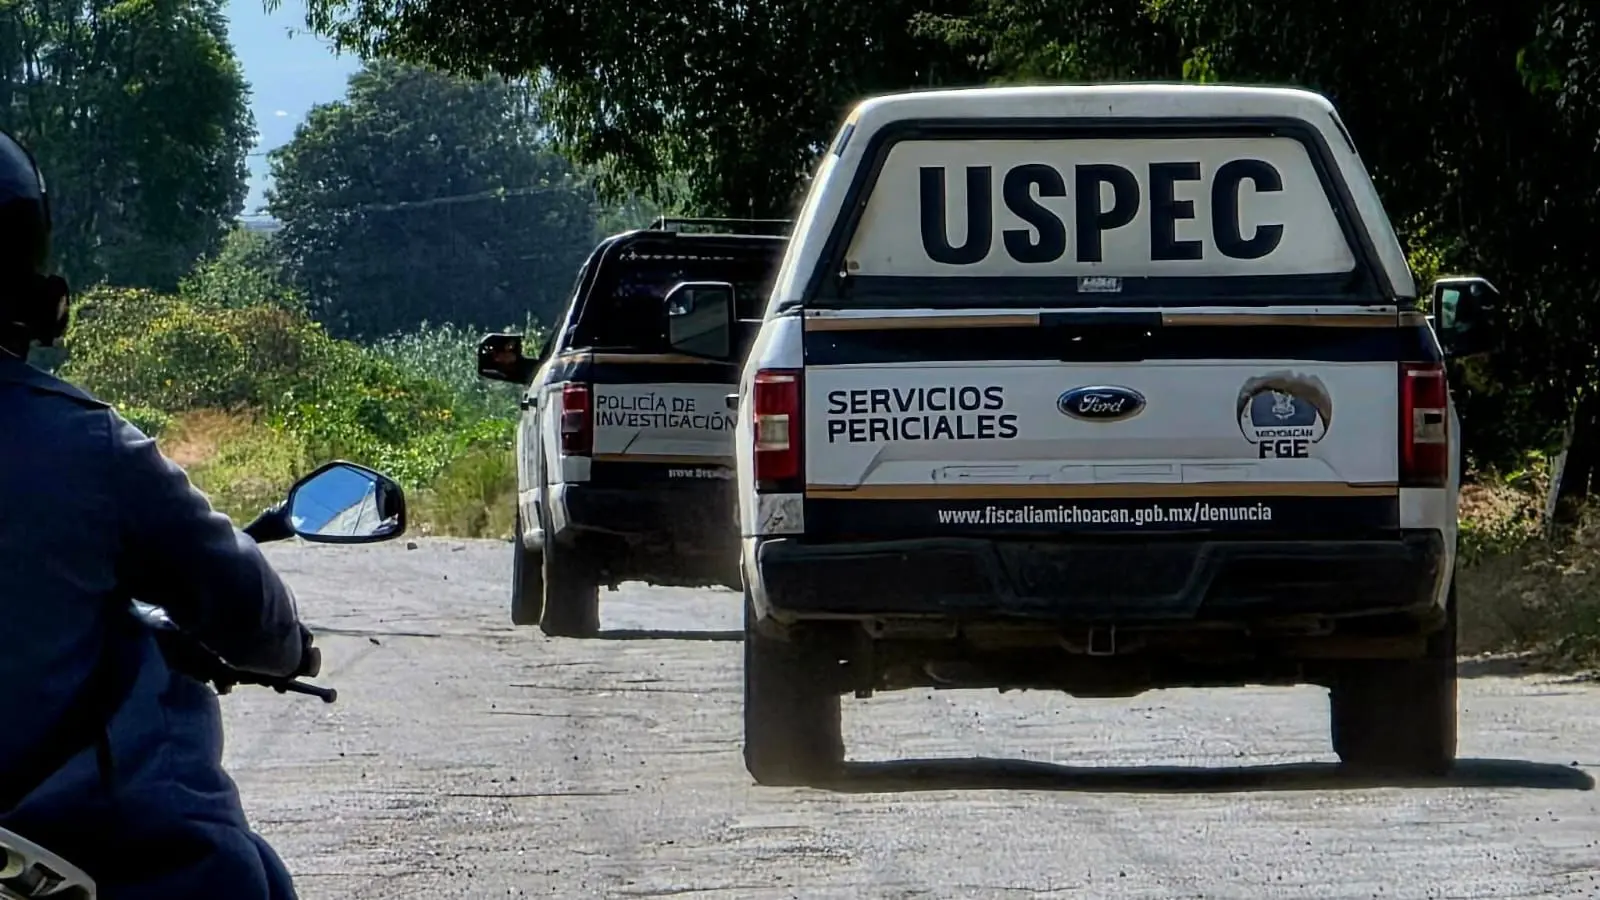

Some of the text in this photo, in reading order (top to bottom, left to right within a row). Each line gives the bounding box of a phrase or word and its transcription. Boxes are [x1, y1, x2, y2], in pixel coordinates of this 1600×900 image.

[919, 159, 1284, 265] USPEC
[596, 392, 696, 412] POLICÍA DE
[828, 386, 1004, 414] SERVICIOS
[1079, 393, 1125, 412] Ford
[596, 411, 737, 431] INVESTIGACIÓN
[828, 415, 1018, 443] PERICIALES
[1259, 439, 1309, 459] FGE
[938, 502, 1272, 526] www.fiscaliamichoacan.gob.mx/denuncia
